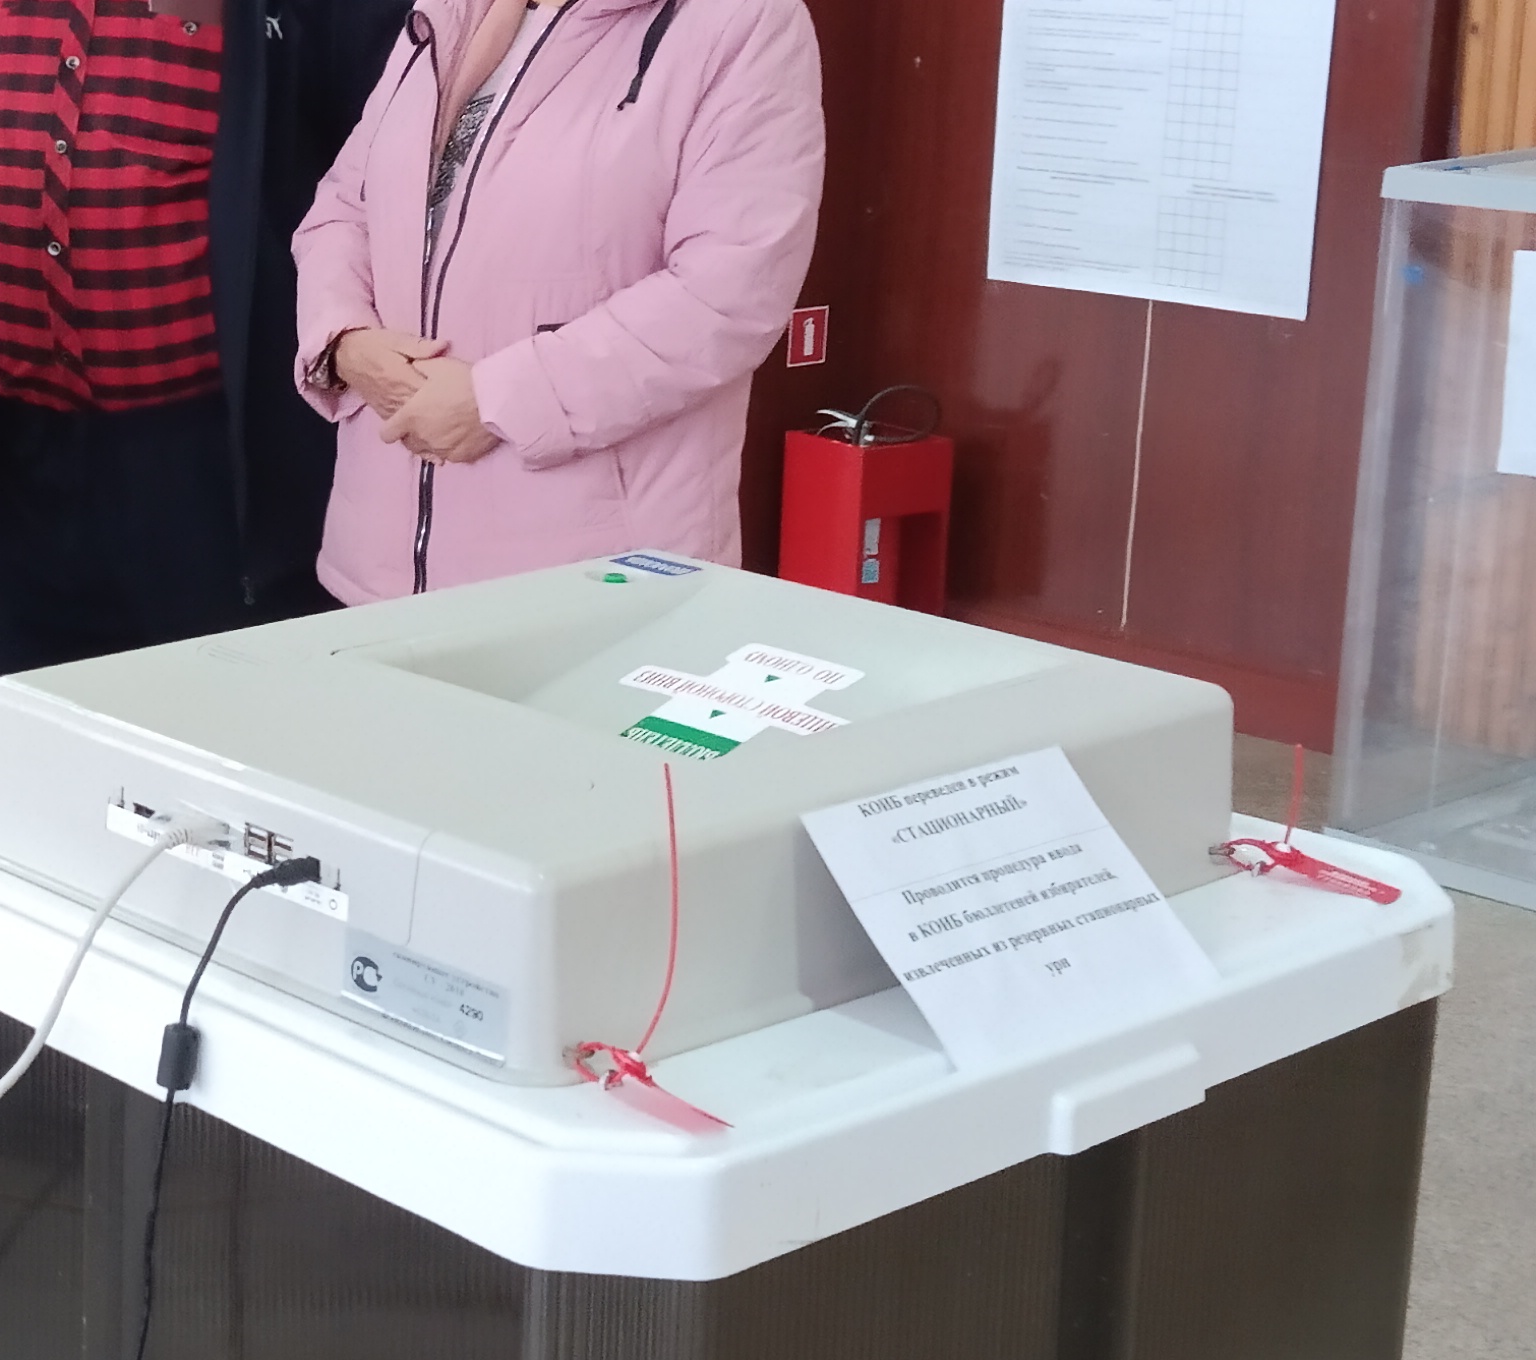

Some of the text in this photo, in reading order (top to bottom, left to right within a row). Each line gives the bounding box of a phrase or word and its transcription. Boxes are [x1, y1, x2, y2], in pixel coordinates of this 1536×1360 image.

[857, 765, 1020, 818] КОИБ переведен в режим
[891, 794, 1028, 845] «СТАЦИОНАРНЫЙ»
[901, 842, 1083, 905] Проводится процедура ввода
[903, 890, 1161, 982] извлеченных из резервных стационарных
[908, 930, 918, 942] в
[917, 912, 964, 939] КОИБ
[963, 888, 1039, 924] бюллетеней
[1045, 956, 1072, 977] урн
